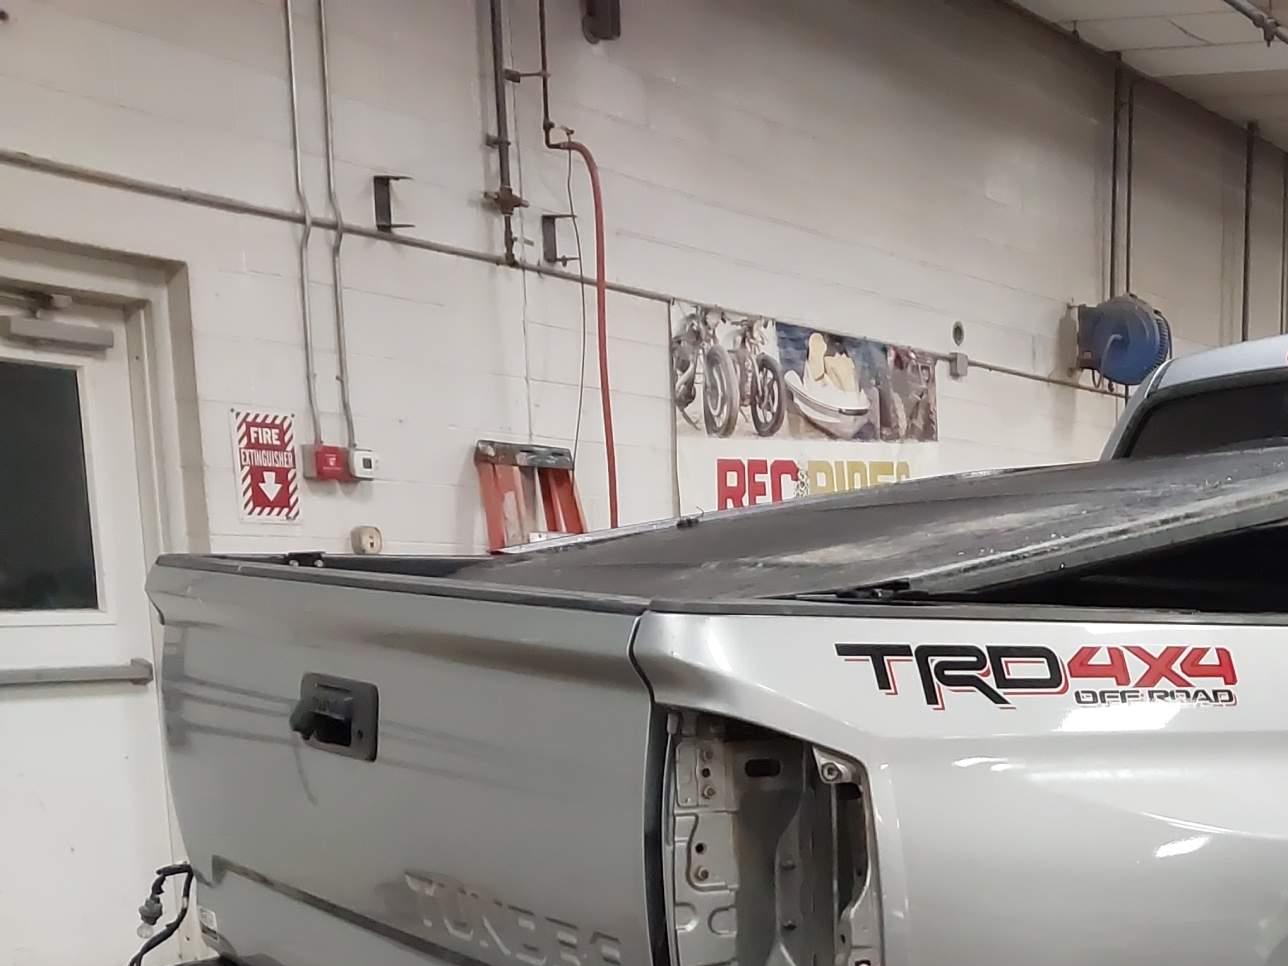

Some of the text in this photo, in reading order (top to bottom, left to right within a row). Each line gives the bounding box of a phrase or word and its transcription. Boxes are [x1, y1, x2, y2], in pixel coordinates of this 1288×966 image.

[250, 427, 281, 445] FIRE
[240, 450, 294, 467] EXTINGUISHER
[717, 458, 799, 511] REC
[835, 643, 1238, 710] TRD 4X4
[1074, 689, 1237, 707] OFF ROAD
